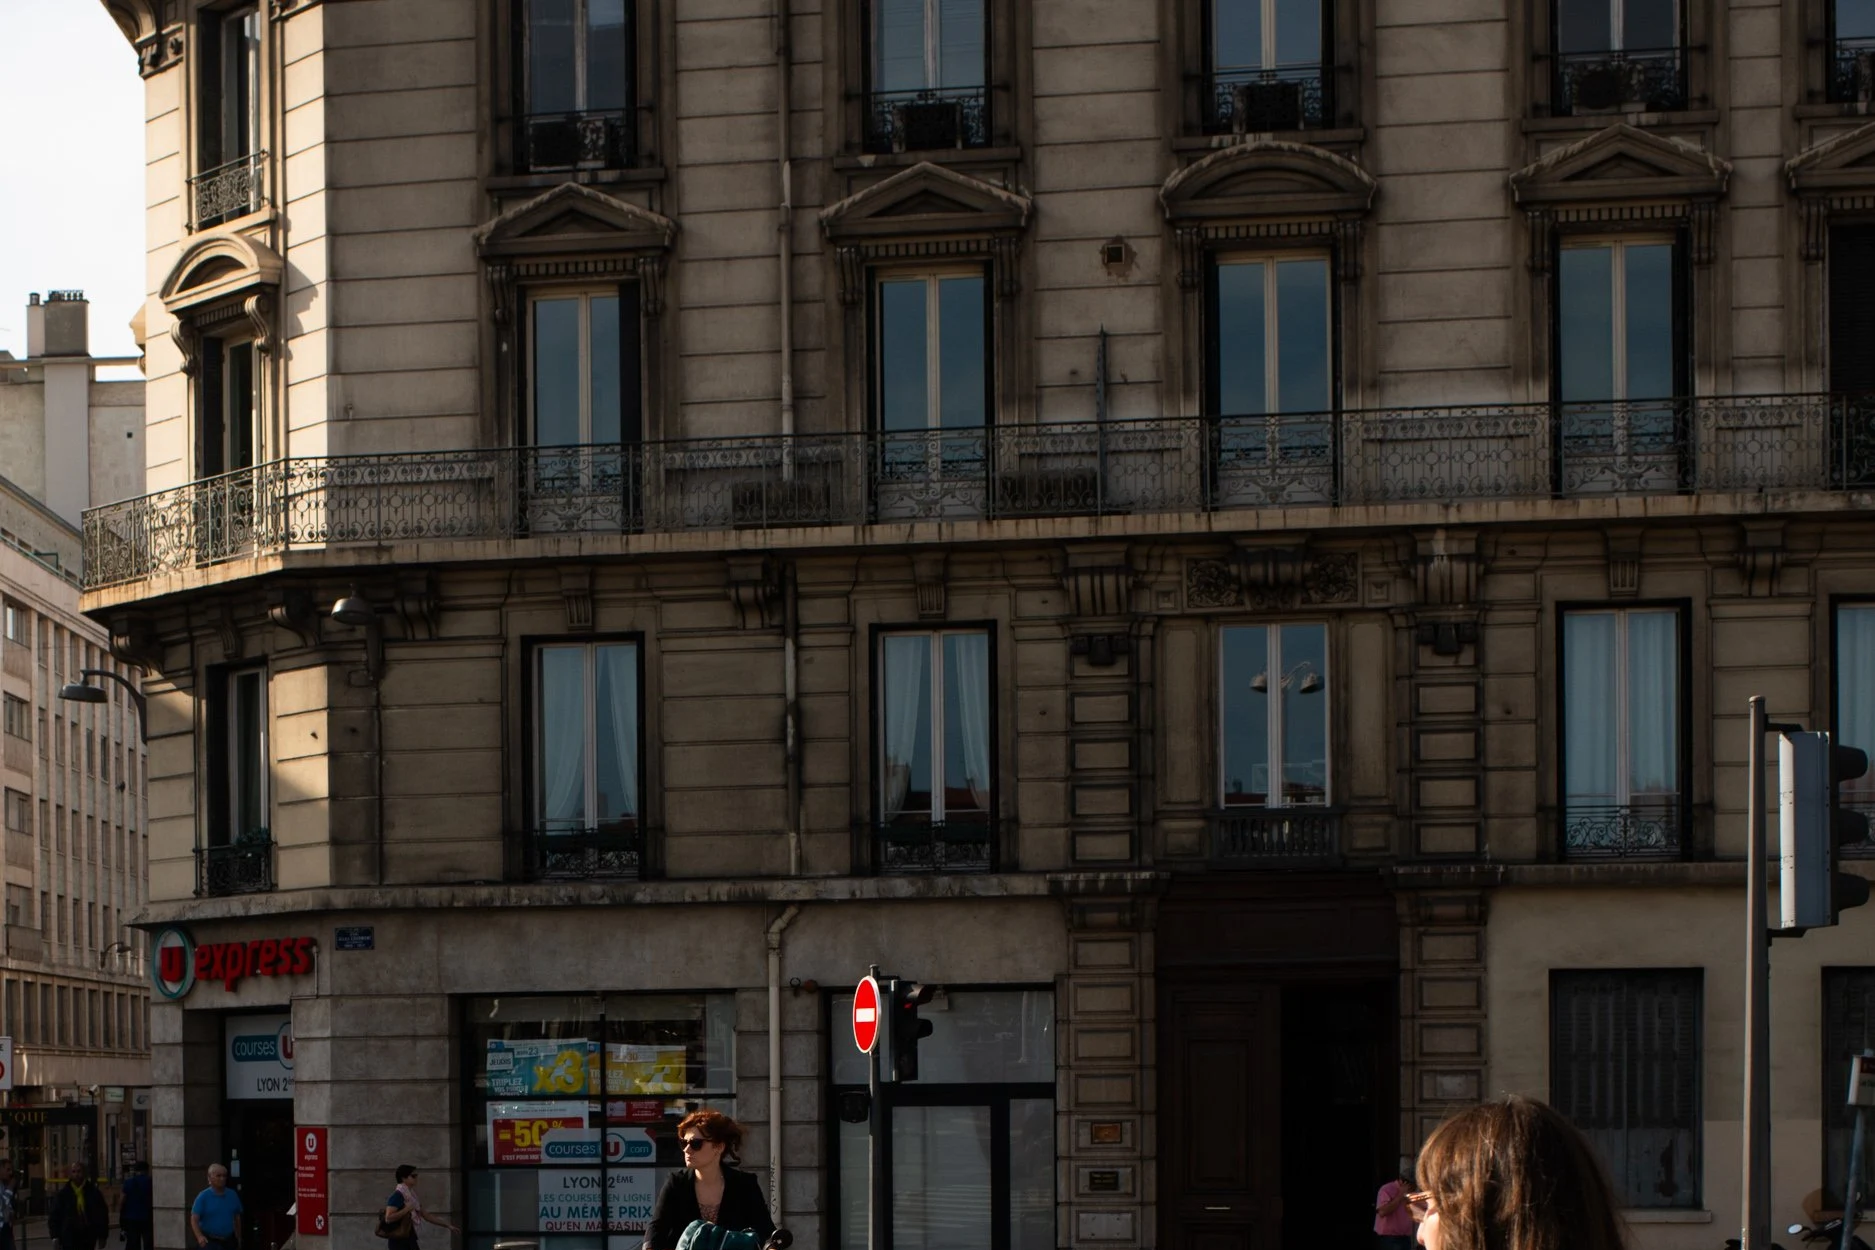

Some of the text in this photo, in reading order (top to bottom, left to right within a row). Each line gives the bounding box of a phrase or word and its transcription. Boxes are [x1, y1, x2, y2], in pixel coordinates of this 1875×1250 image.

[194, 937, 315, 993] express
[234, 1035, 293, 1059] courses U
[528, 1047, 538, 1056] 23
[532, 1050, 585, 1094] x3
[257, 1078, 280, 1092] LYON
[491, 1077, 522, 1087] TRIPLEZ
[548, 1144, 597, 1156] courses
[563, 1176, 601, 1188] LYON
[540, 1193, 652, 1202] LES COURSES EN LIGNE
[539, 1203, 653, 1218] AU MÊME PRIX
[545, 1221, 581, 1231] QU'EN
